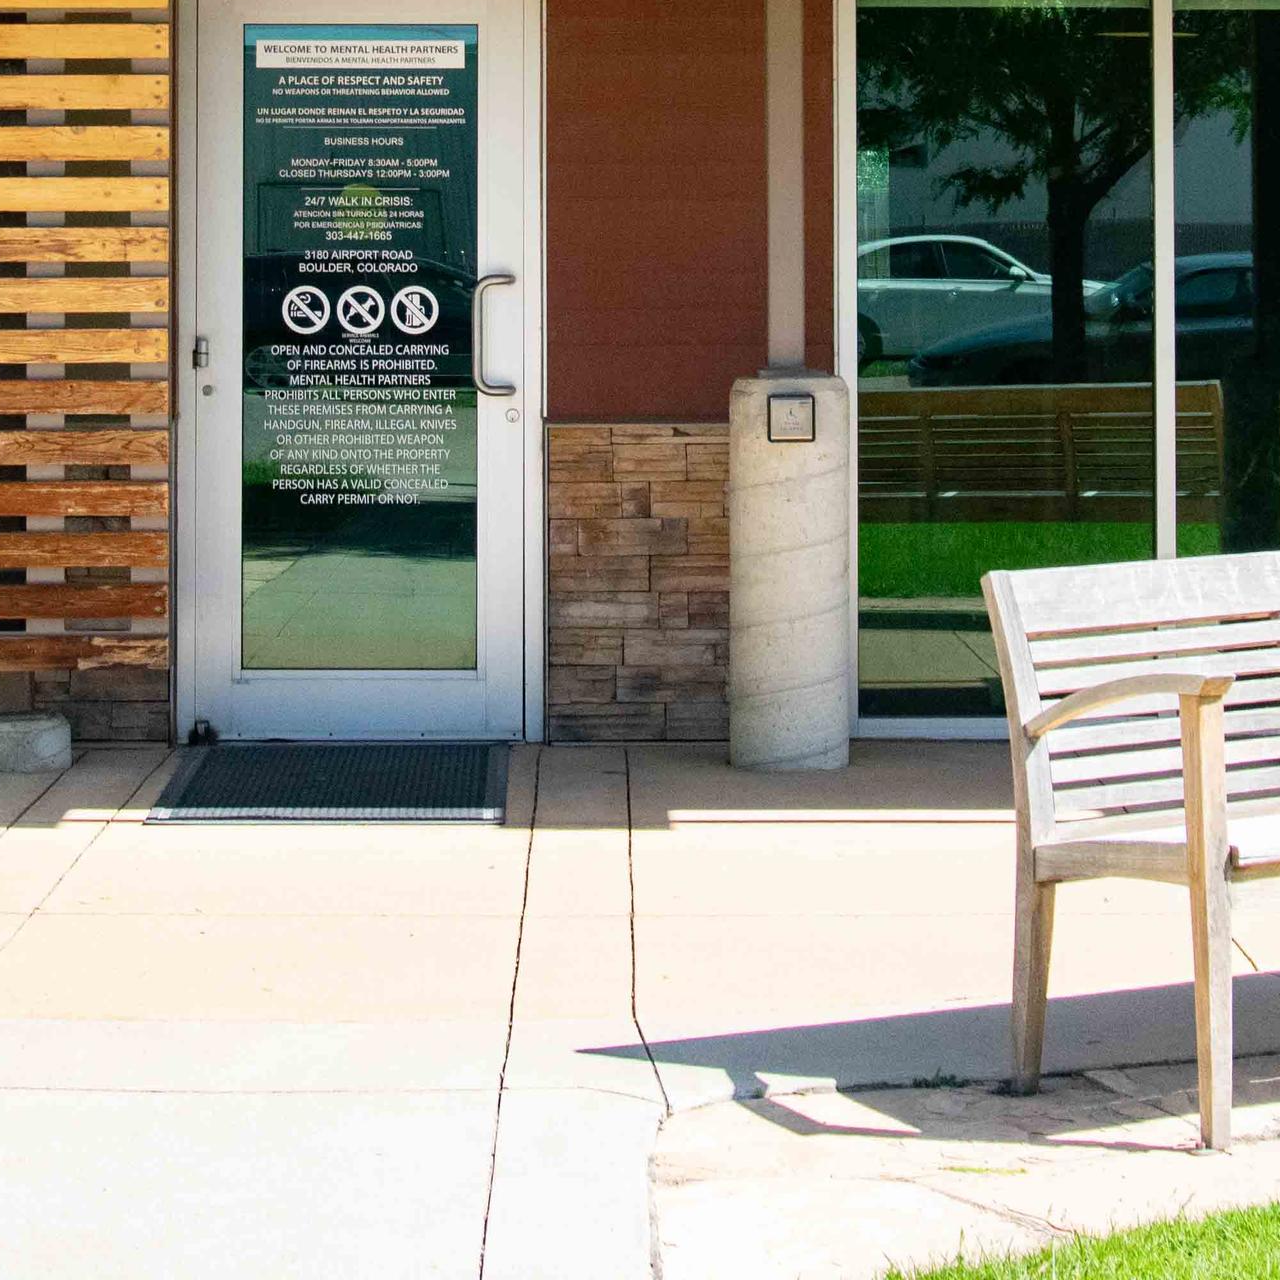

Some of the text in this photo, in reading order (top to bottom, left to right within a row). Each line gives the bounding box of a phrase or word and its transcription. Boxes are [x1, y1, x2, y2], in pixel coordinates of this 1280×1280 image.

[264, 45, 458, 54] WELCOME TO MENTAL HEALTH PARTNERS
[279, 76, 444, 85] A PLACE OF RESPECT AND SAFETY
[272, 88, 450, 96] NO WEAPONS OR THREATENING BEHAVIOR ALLOWED
[257, 108, 465, 116] UN LUGAR DONDE REINAN EL RESPETO Y LA SEGURIDAD
[324, 138, 404, 146] BUSINESS HOURS
[291, 158, 366, 167] MONDAY-FRIDAY
[406, 158, 438, 167] 5:00PM
[279, 170, 316, 178] CLOSED
[318, 170, 373, 178] THURSDAYS
[376, 170, 411, 178] 12:00PM
[419, 170, 450, 178] 3:00PM
[305, 196, 413, 206] 24/7 WALK IN CRISIS:
[293, 209, 331, 218] ATENCIÓN
[294, 221, 310, 229] POR
[325, 231, 392, 241] 303-447-1665
[305, 250, 413, 260] 3180 AIRPORT ROAD
[299, 263, 418, 274] BOULDER, COLORADO
[271, 345, 450, 356] OPEN AND CONCEALED CARRYING
[287, 360, 438, 370] OF FIREARMS IS PROHIBITED.
[289, 375, 431, 385] MENTAL HEALTH PARTNERS
[264, 390, 456, 400] PROHIBITS ALL PERSONS WHO ENTER
[268, 405, 453, 415] THESE PREMISES FROM CARRYING A
[264, 420, 457, 431] HANDGUN, FIREARM, ILLEGAL KNIVES
[276, 434, 444, 445] OR OTHER PROHIBITED WEAPON
[270, 449, 451, 460] OF ANY KIND ONTO THE PROPERTY
[280, 464, 441, 475] REGARDLESS OF WHETHER THE
[272, 479, 449, 490] PERSON HAS A VALID CONCEALED
[300, 494, 421, 504] CARRY PERMIT OR NOT.
